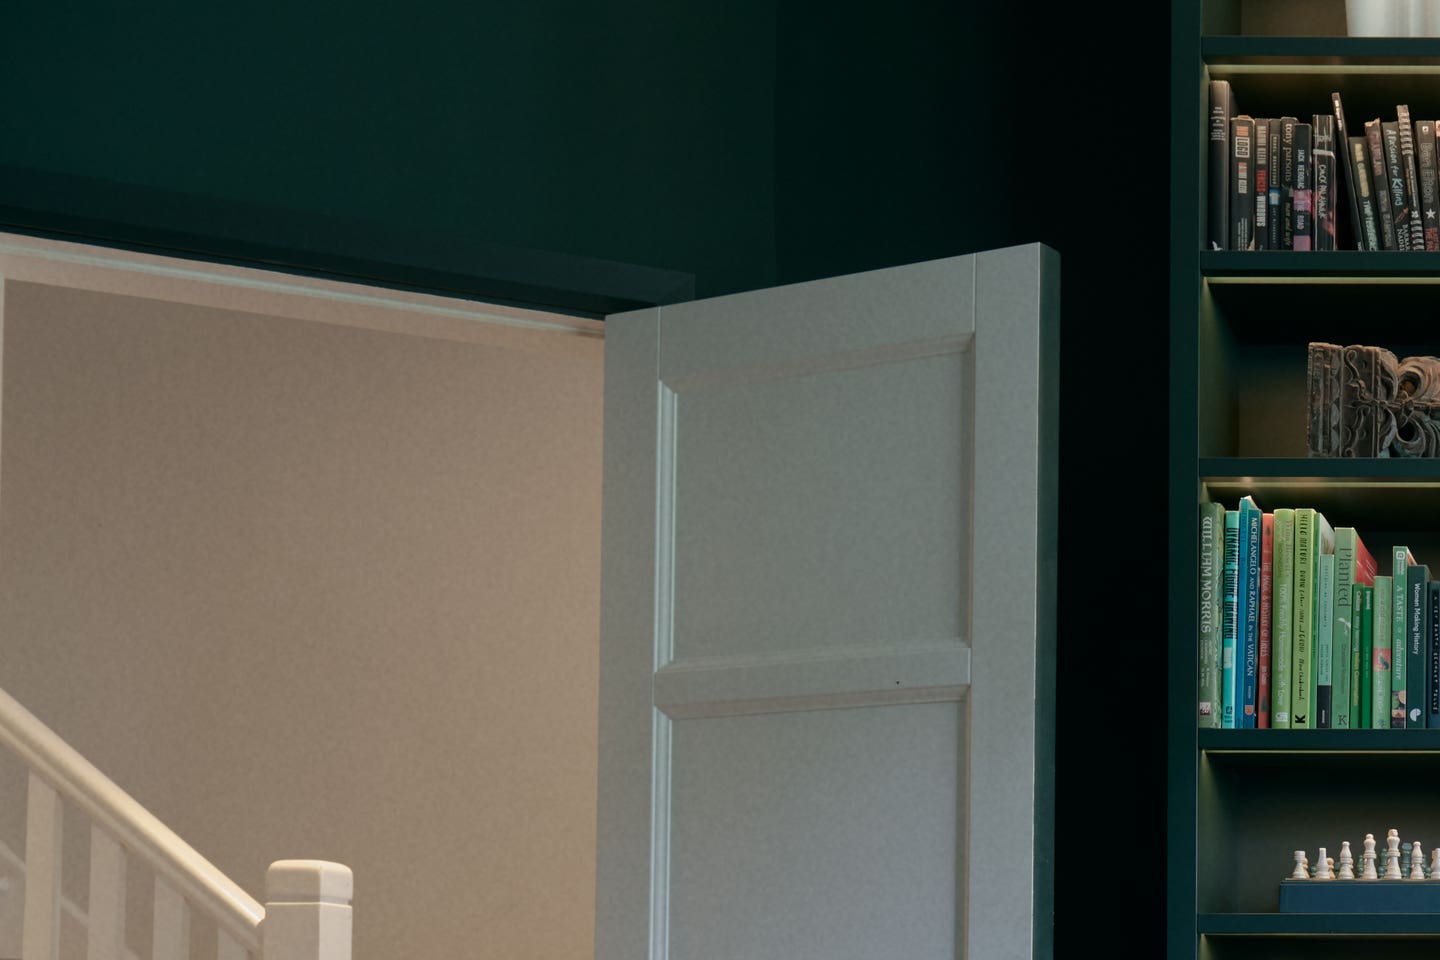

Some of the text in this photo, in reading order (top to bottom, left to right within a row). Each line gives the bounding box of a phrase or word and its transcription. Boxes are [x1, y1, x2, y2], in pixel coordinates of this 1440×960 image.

[1236, 126, 1249, 157] NO LOGO
[1283, 123, 1293, 182] tony parsons
[1249, 517, 1258, 575] MICHELANGELO
[1337, 547, 1353, 607] Planted
[1248, 590, 1256, 622] RAPHAEL
[1412, 583, 1421, 655] Women Making History
[1247, 644, 1255, 676] VATICAN
[1395, 638, 1403, 680] adventure
